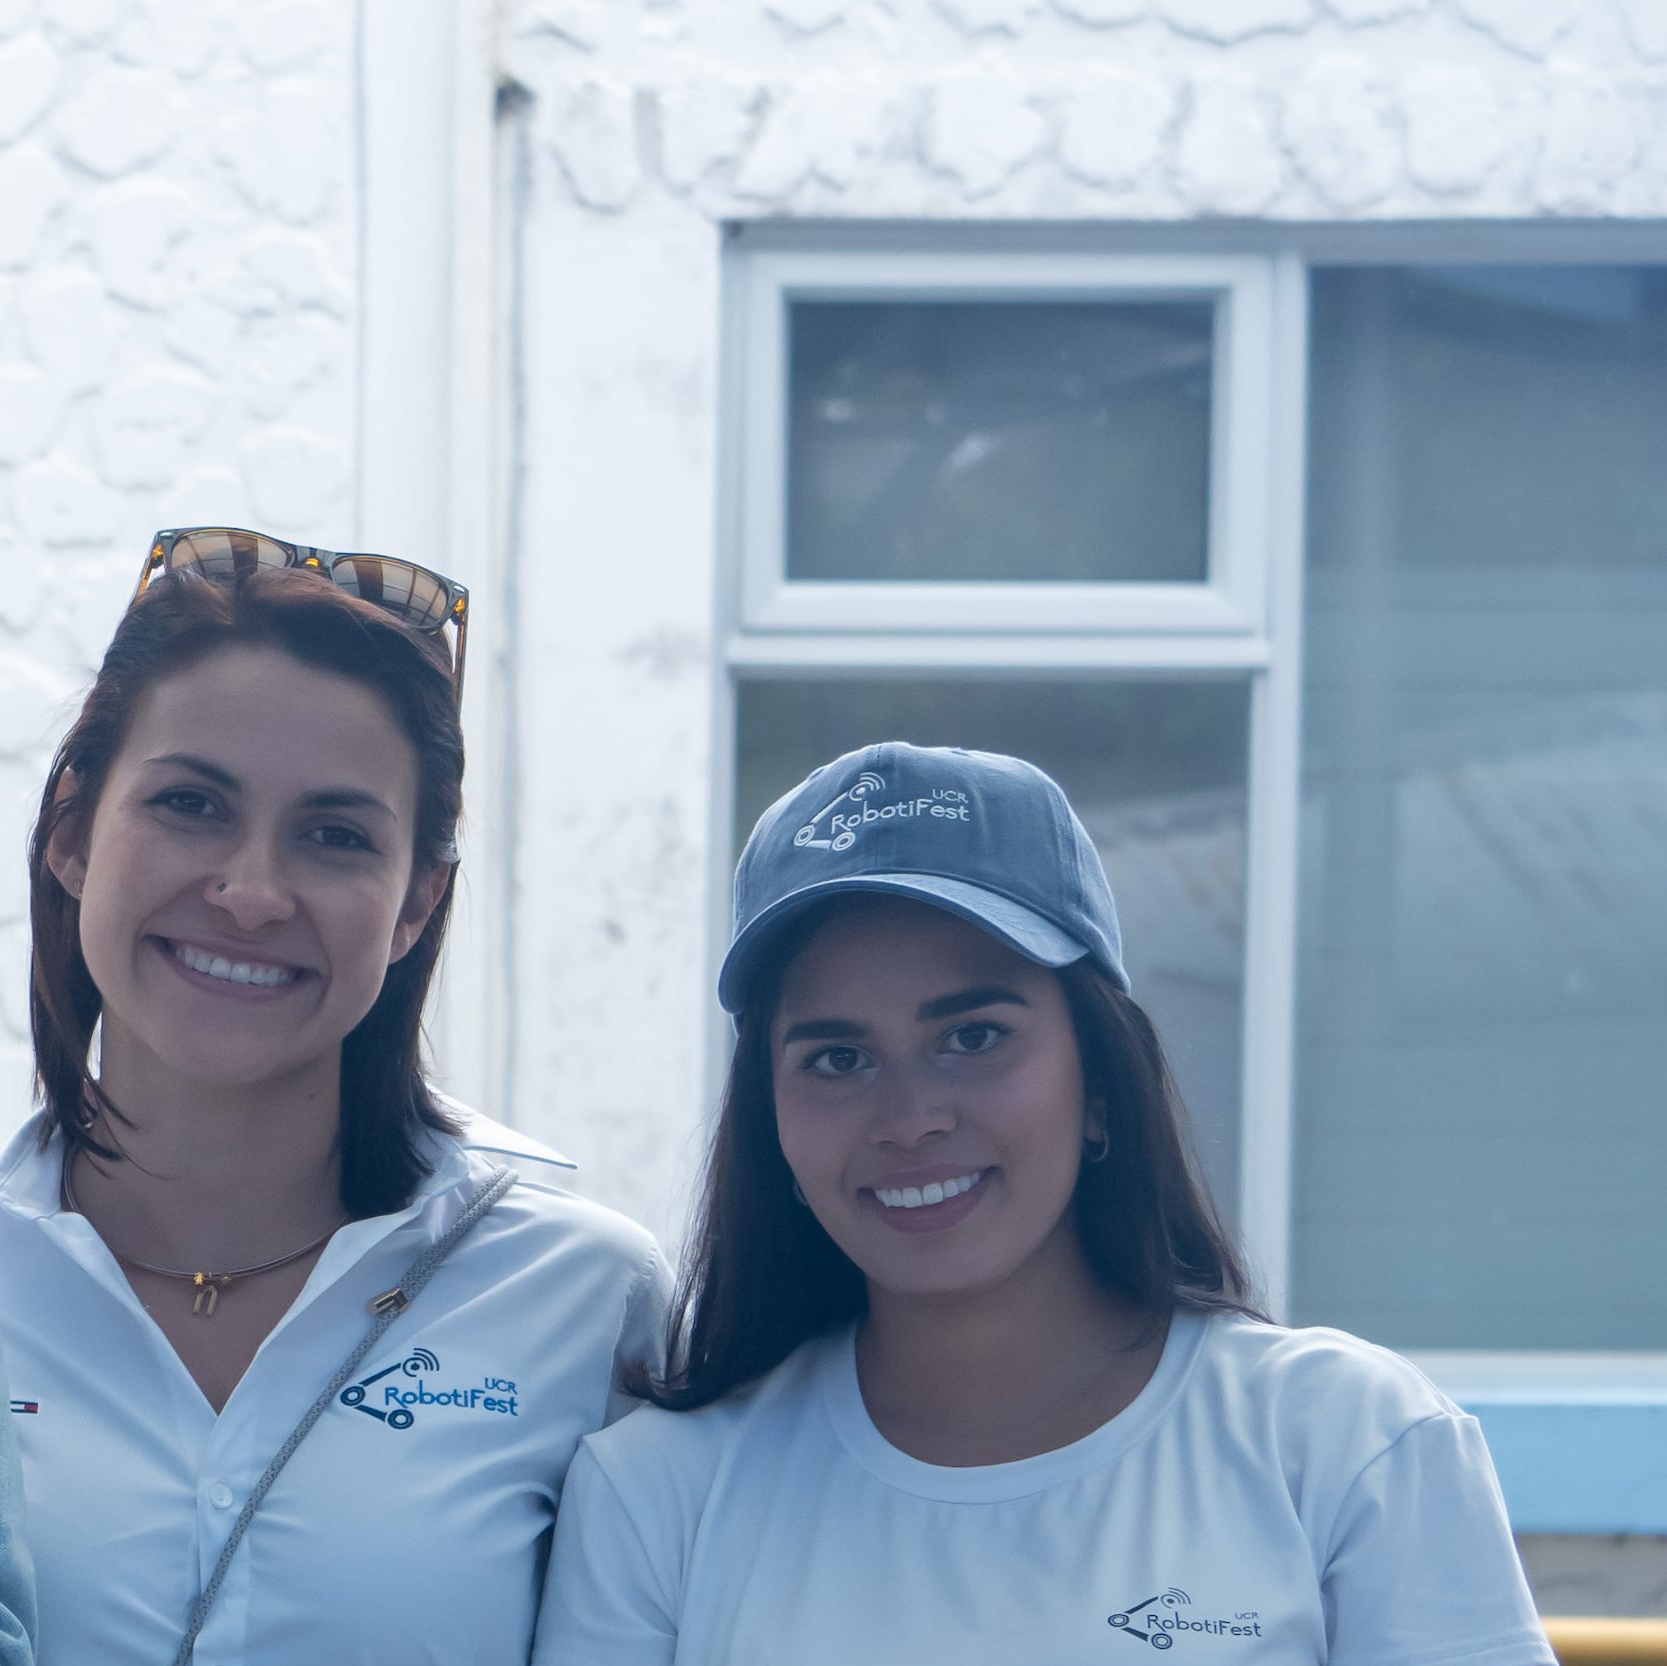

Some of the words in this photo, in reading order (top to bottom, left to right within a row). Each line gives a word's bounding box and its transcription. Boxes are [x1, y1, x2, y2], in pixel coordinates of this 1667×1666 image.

[932, 787, 968, 804] UCR
[831, 798, 970, 835] RobotiFest
[484, 1377, 518, 1395] UCR
[385, 1379, 518, 1416] RobotiFest
[1146, 1611, 1262, 1637] RobotiFest
[1235, 1611, 1260, 1620] UCR
